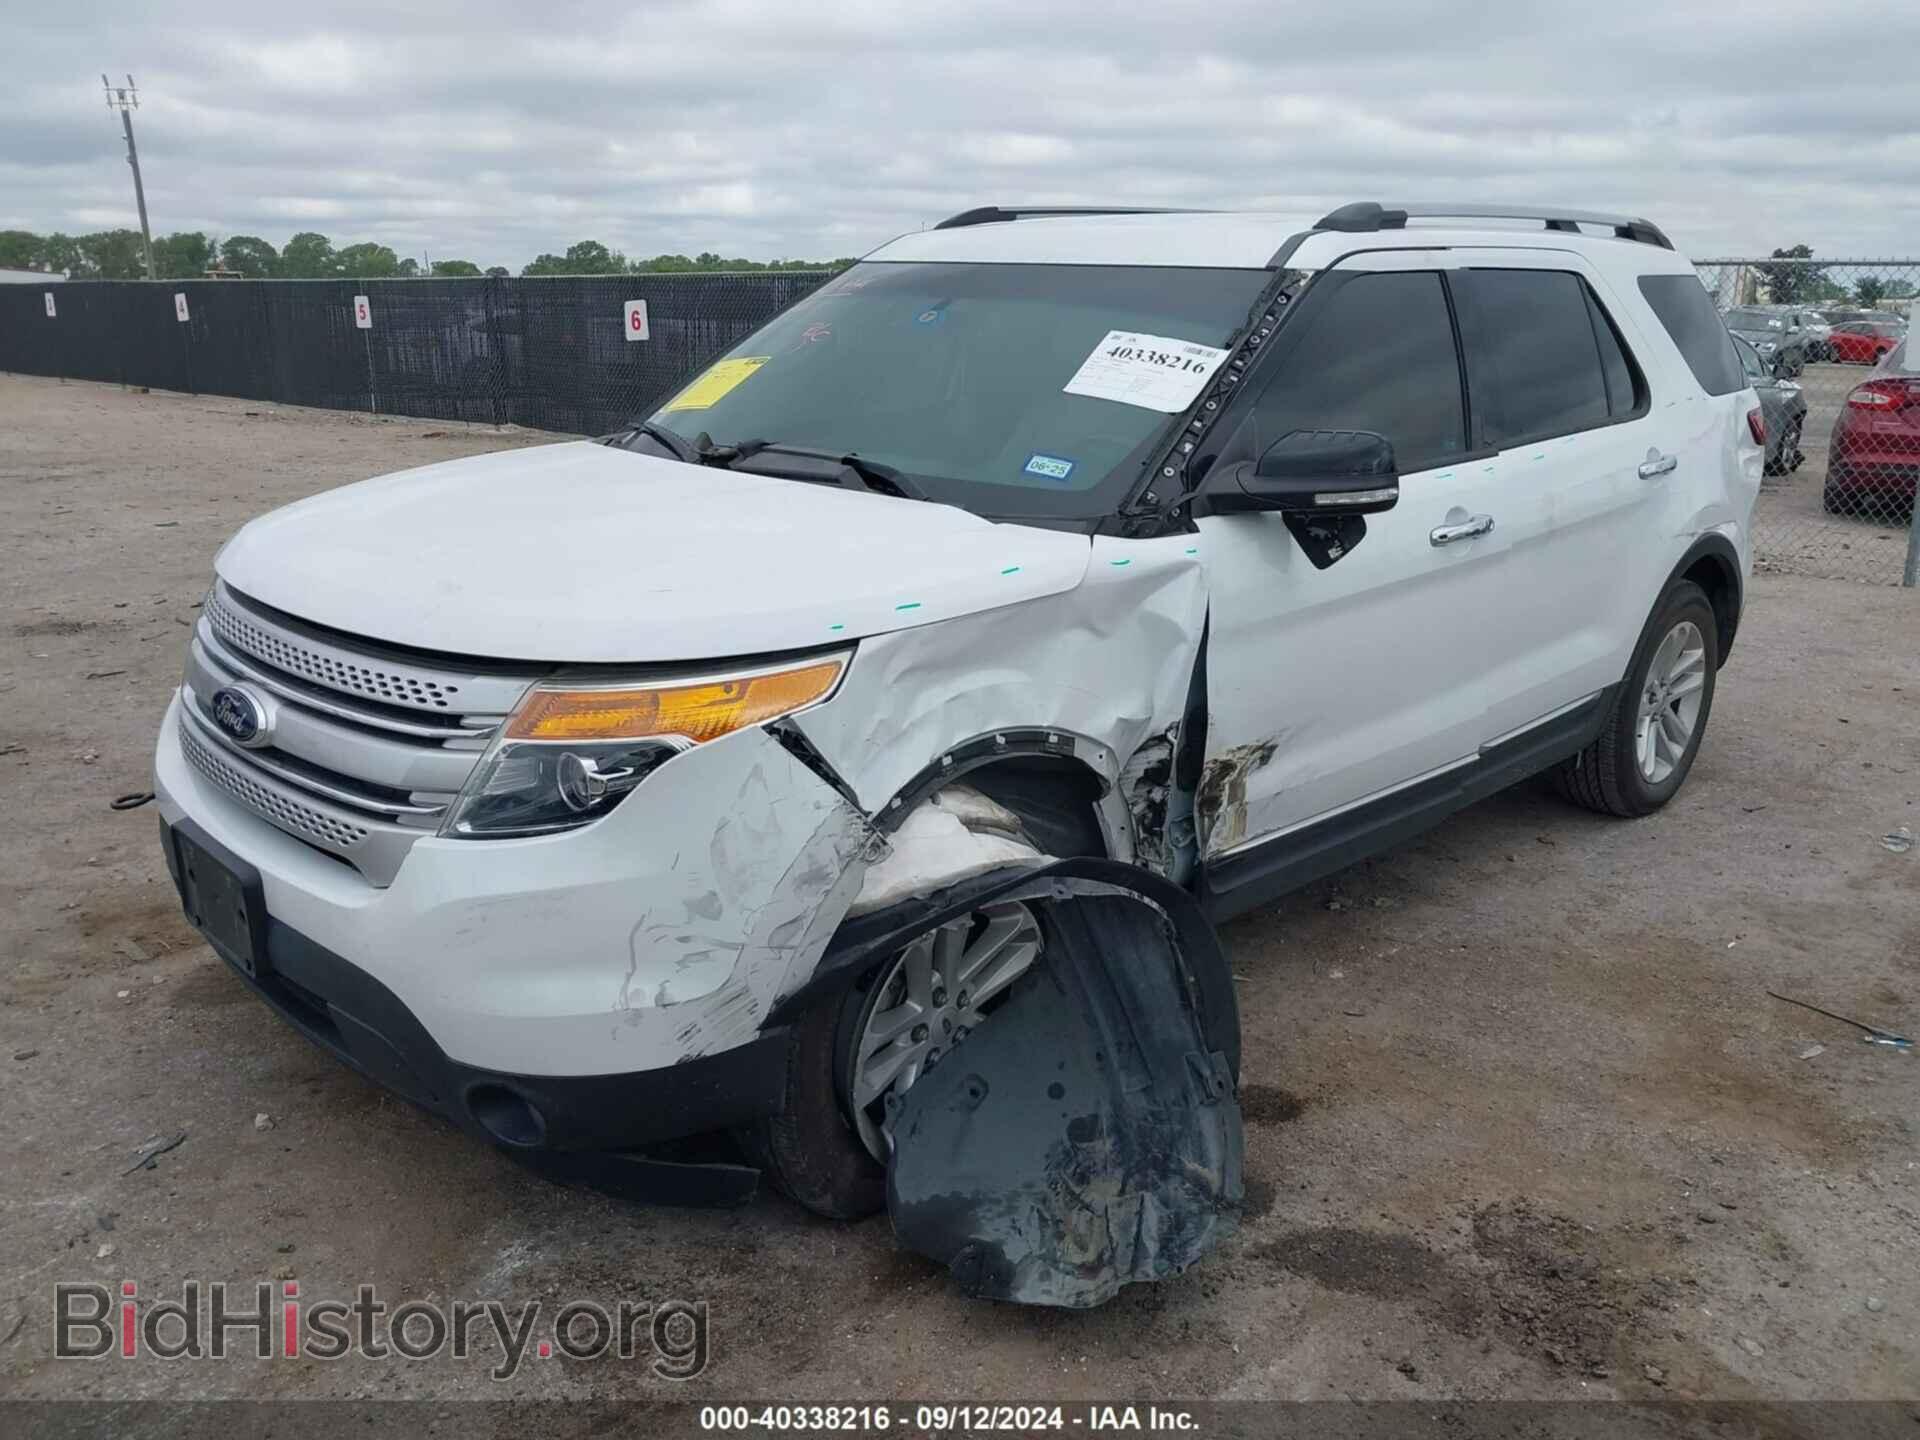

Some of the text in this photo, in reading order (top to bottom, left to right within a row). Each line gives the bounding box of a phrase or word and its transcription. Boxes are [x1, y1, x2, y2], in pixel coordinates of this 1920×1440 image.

[358, 303, 368, 321] 5
[630, 309, 642, 331] 6
[1106, 345, 1206, 375] 40338216
[217, 694, 247, 732] Ford
